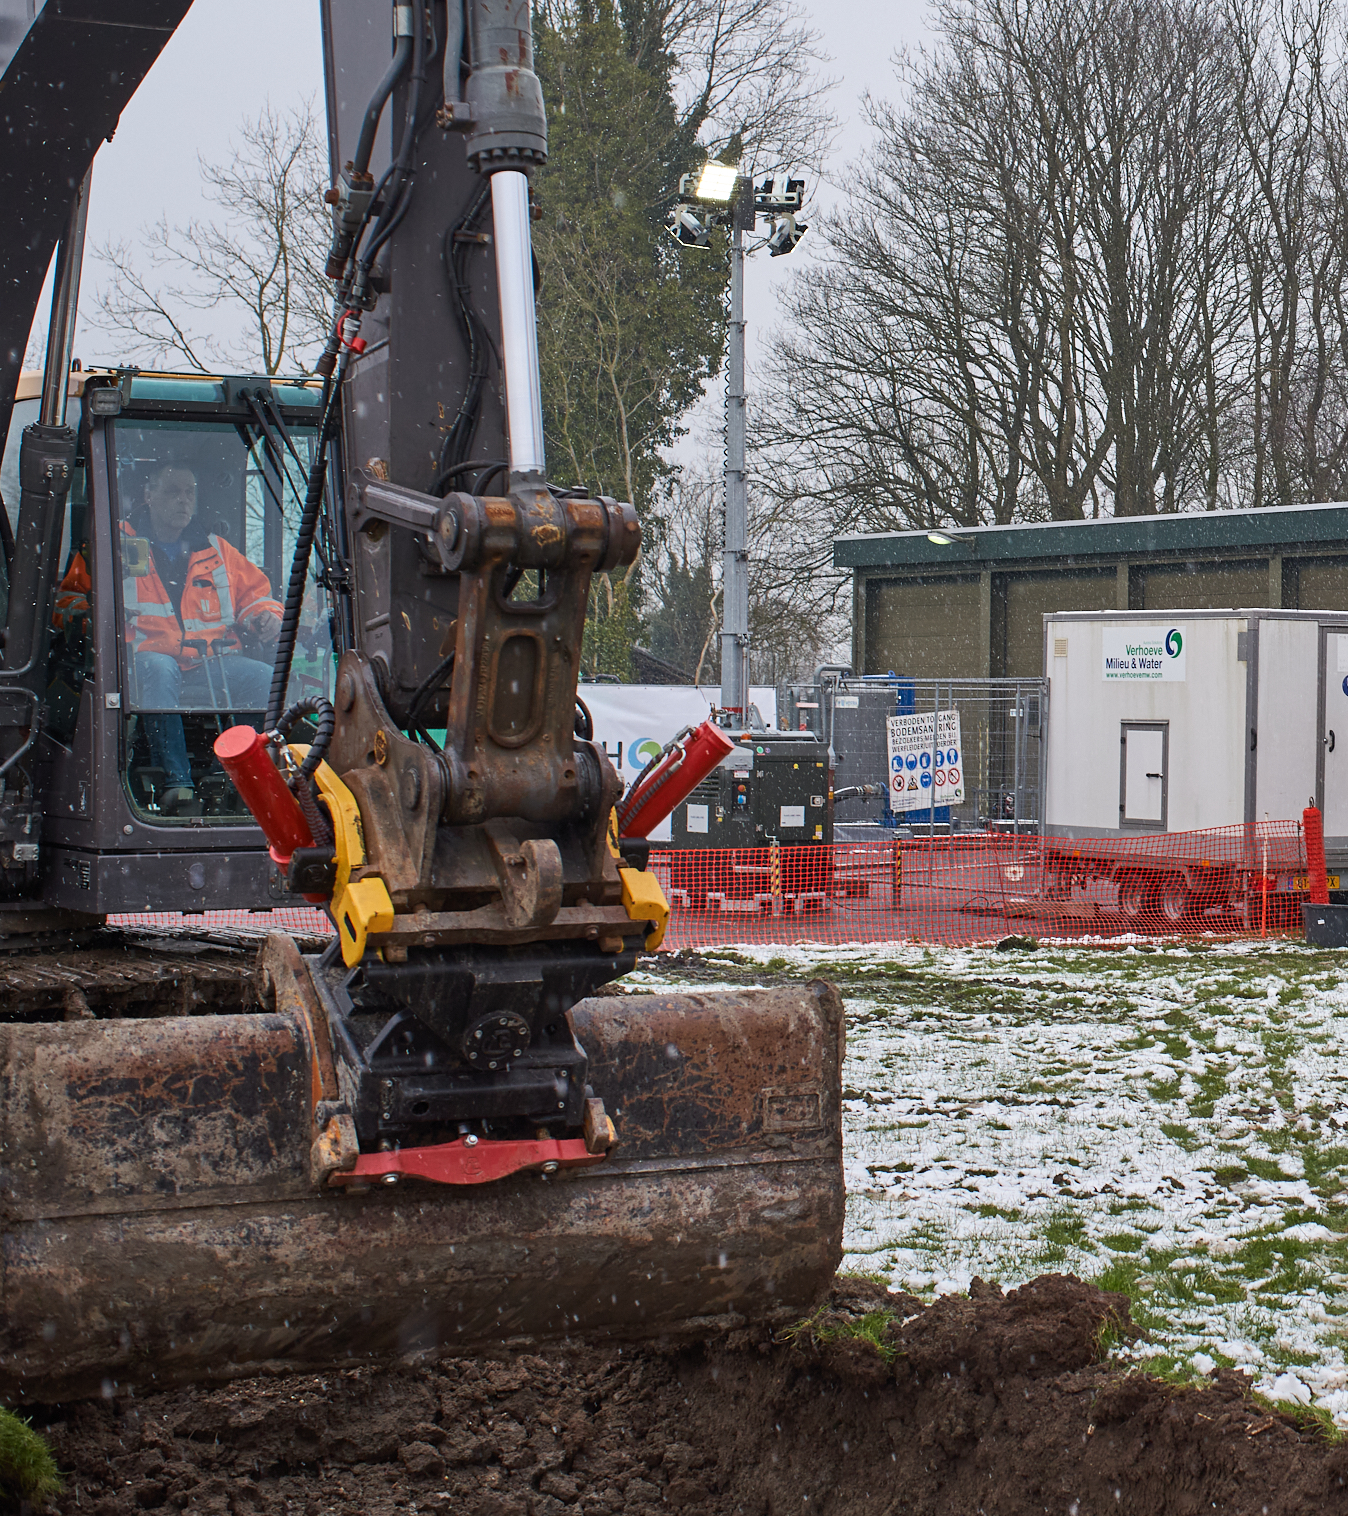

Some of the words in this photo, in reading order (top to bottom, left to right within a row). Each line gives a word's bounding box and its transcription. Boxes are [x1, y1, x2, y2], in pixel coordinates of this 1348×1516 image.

[1126, 645, 1163, 655] Verhoeve
[1106, 658, 1129, 669] Milieu
[1131, 658, 1137, 669] &
[1139, 658, 1163, 669] Water
[891, 716, 925, 727] VERBODEN
[927, 713, 956, 723] TOGANG
[891, 722, 957, 737] BODEMSANRING
[925, 732, 947, 741] MEDEN
